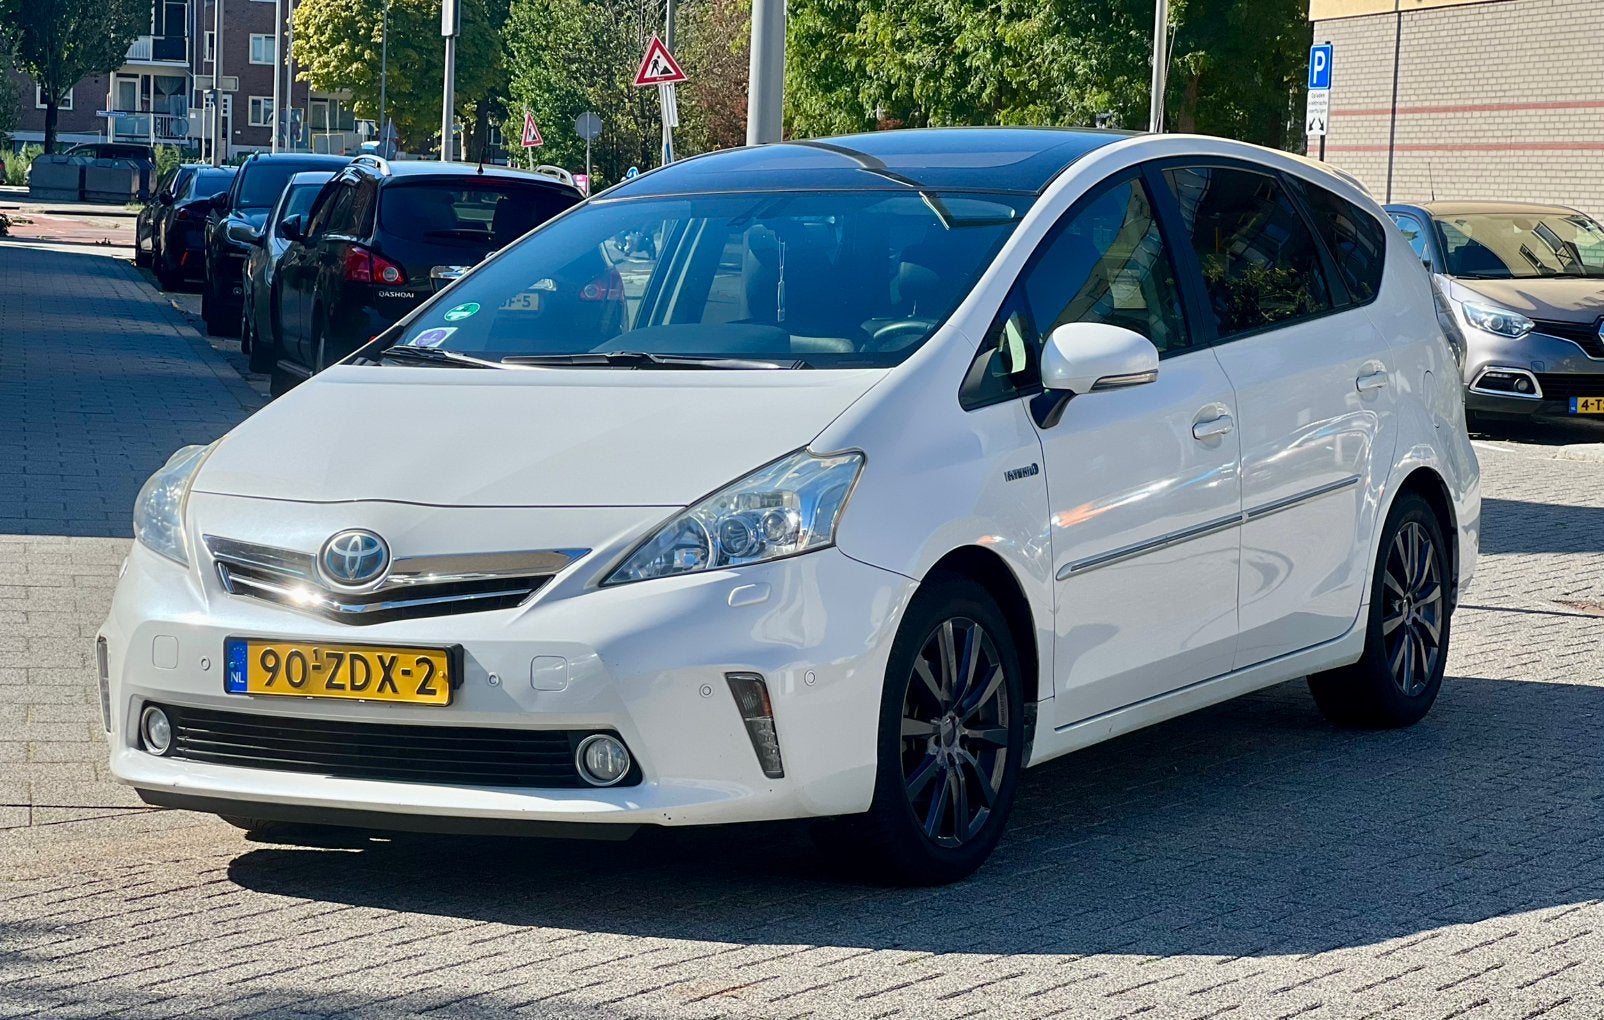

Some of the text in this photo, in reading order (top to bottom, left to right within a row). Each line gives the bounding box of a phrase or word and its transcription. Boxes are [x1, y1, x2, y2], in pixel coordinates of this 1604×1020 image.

[1313, 50, 1326, 84] P
[378, 290, 415, 298] QASHQAI
[1581, 399, 1604, 411] 4-T
[230, 671, 245, 684] NL
[259, 648, 438, 696] 90-ZDX-2
